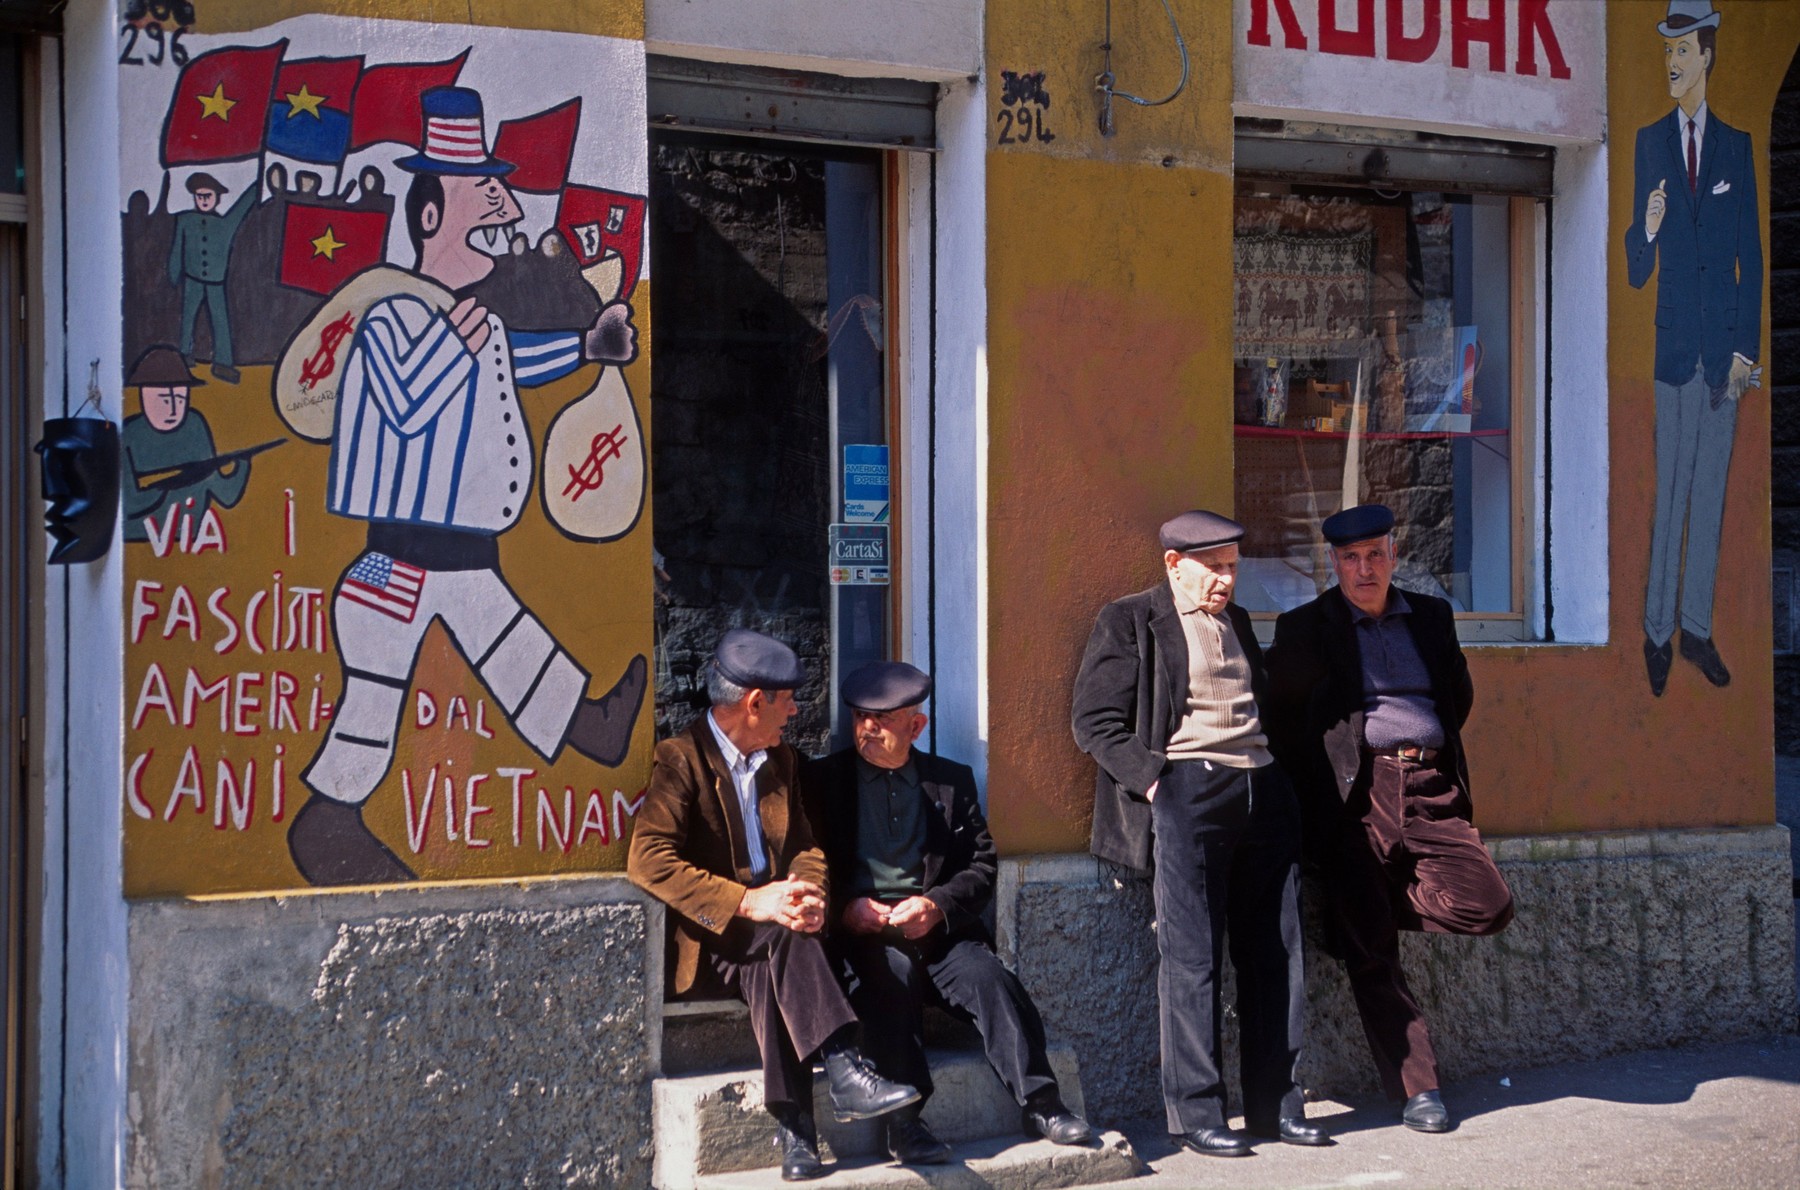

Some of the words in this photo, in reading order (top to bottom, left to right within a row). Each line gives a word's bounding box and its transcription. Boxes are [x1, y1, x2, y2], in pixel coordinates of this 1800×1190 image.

[118, 22, 189, 67] 296
[997, 107, 1056, 144] 294
[561, 423, 628, 502] $
[845, 464, 887, 474] AMERICAN
[853, 475, 889, 485] EXPRESS
[416, 688, 495, 740] DAL
